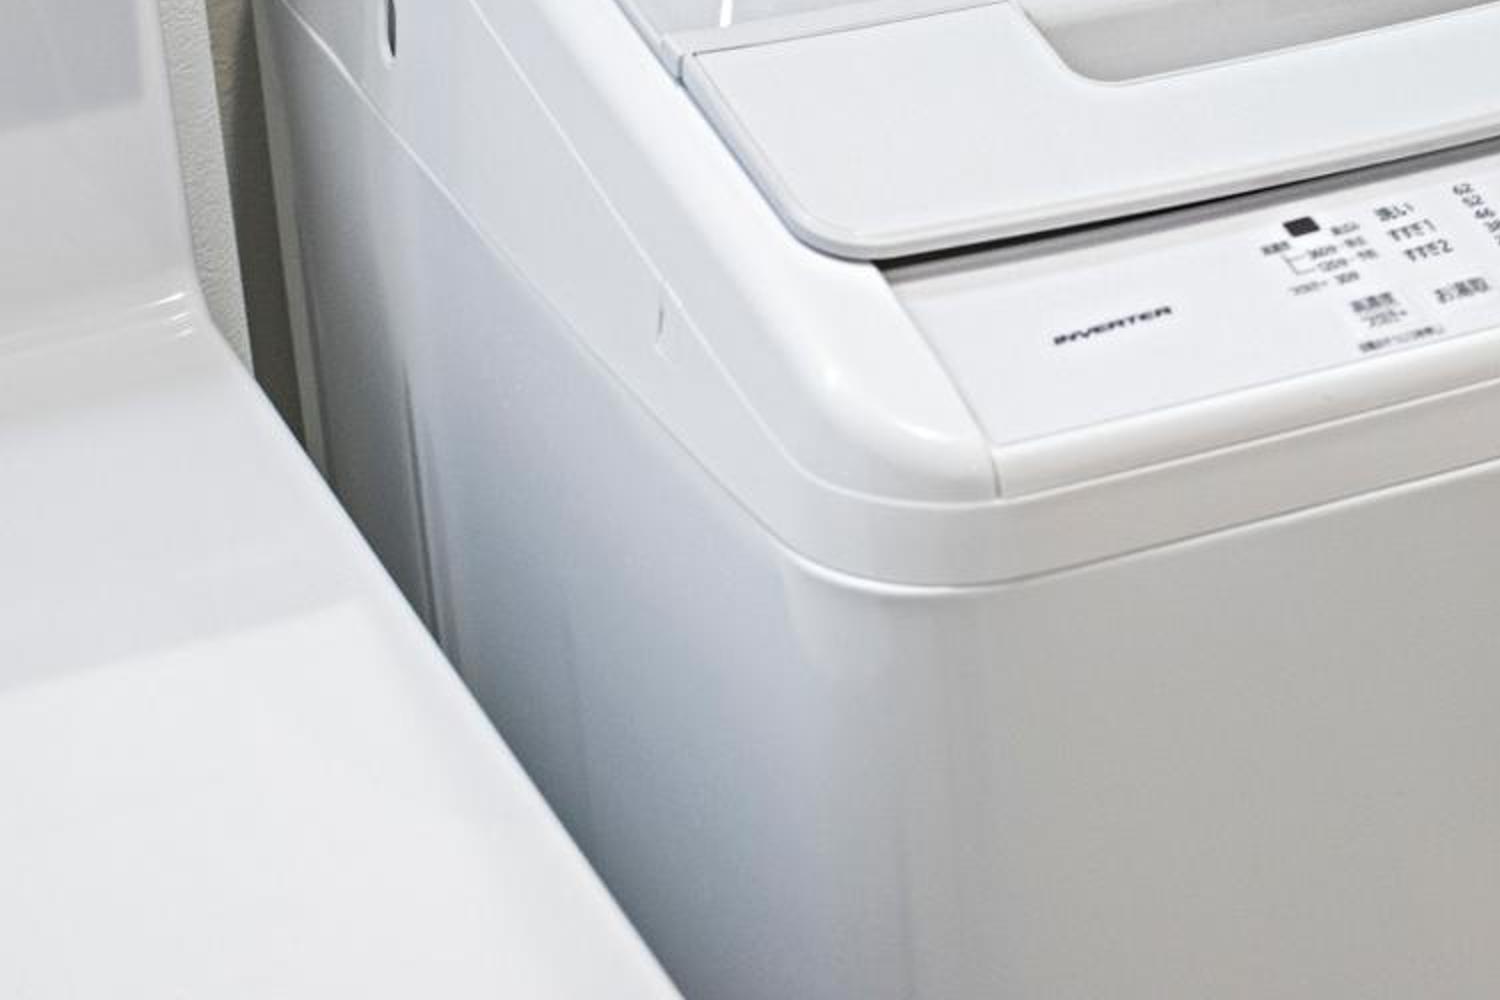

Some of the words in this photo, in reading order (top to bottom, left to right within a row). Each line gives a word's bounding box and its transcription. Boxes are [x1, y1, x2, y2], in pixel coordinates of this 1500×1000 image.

[1453, 183, 1474, 196] 62
[1374, 202, 1415, 222] 洗い
[1388, 218, 1438, 242] すすぎ1
[1404, 238, 1454, 262] すすぎ2
[1053, 306, 1172, 345] INVERTER
